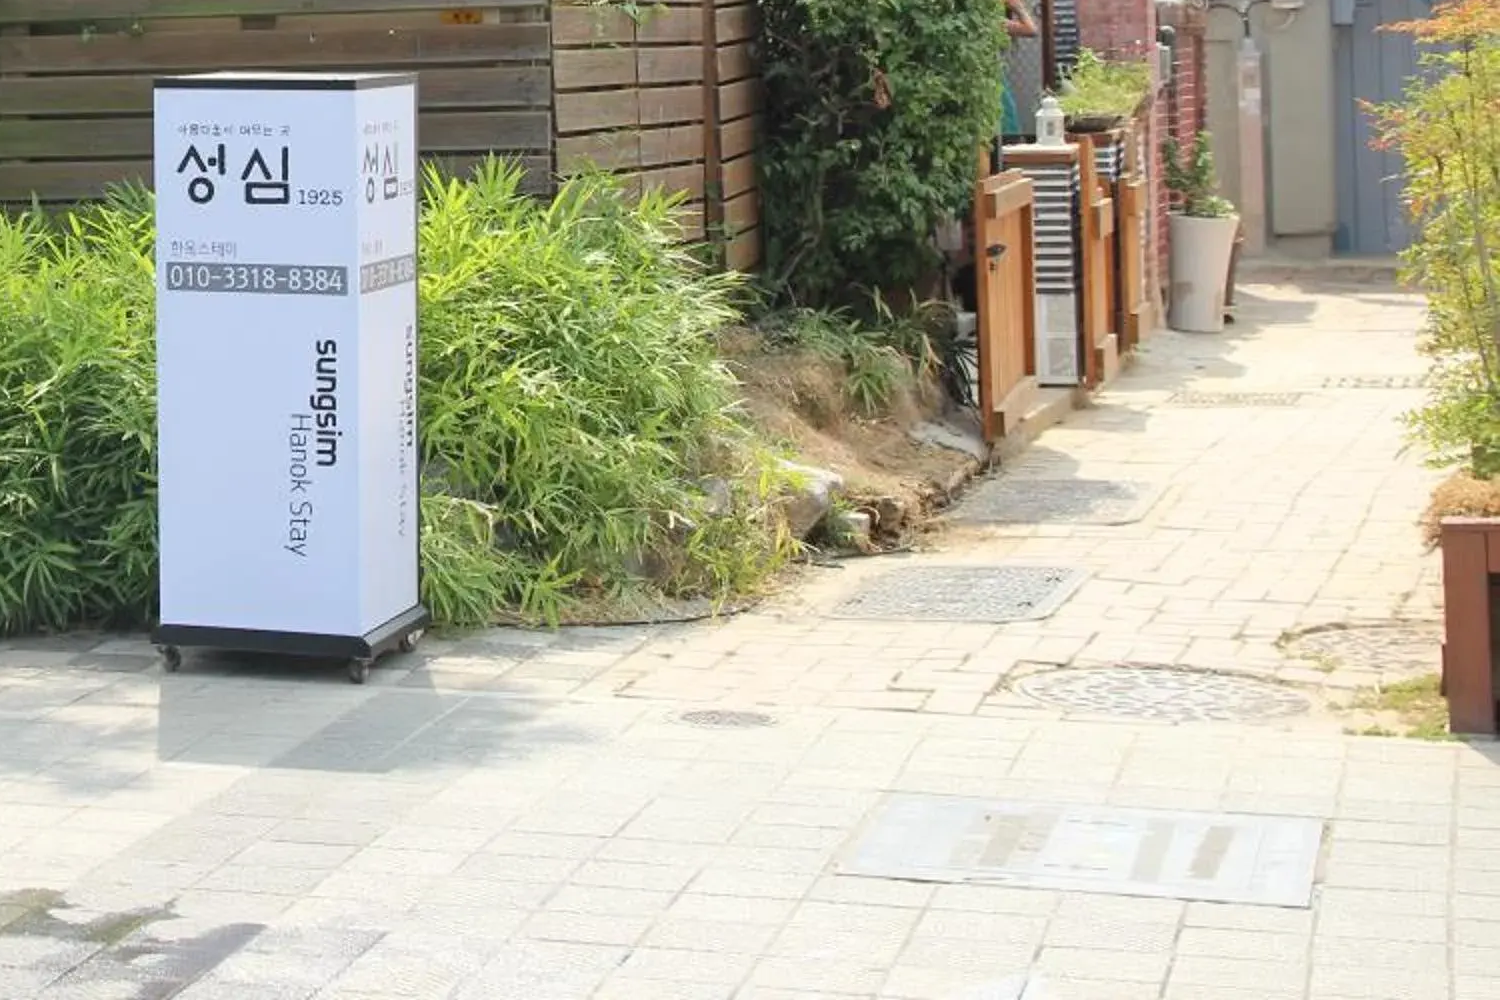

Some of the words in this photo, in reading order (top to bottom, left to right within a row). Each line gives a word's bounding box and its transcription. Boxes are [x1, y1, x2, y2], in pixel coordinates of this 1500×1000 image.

[176, 142, 291, 205] 성심
[297, 188, 344, 206] 1925
[170, 264, 344, 292] 010-3318-8384
[309, 338, 344, 468] sungsim
[289, 413, 313, 493] Hanok
[283, 500, 313, 558] Stay
